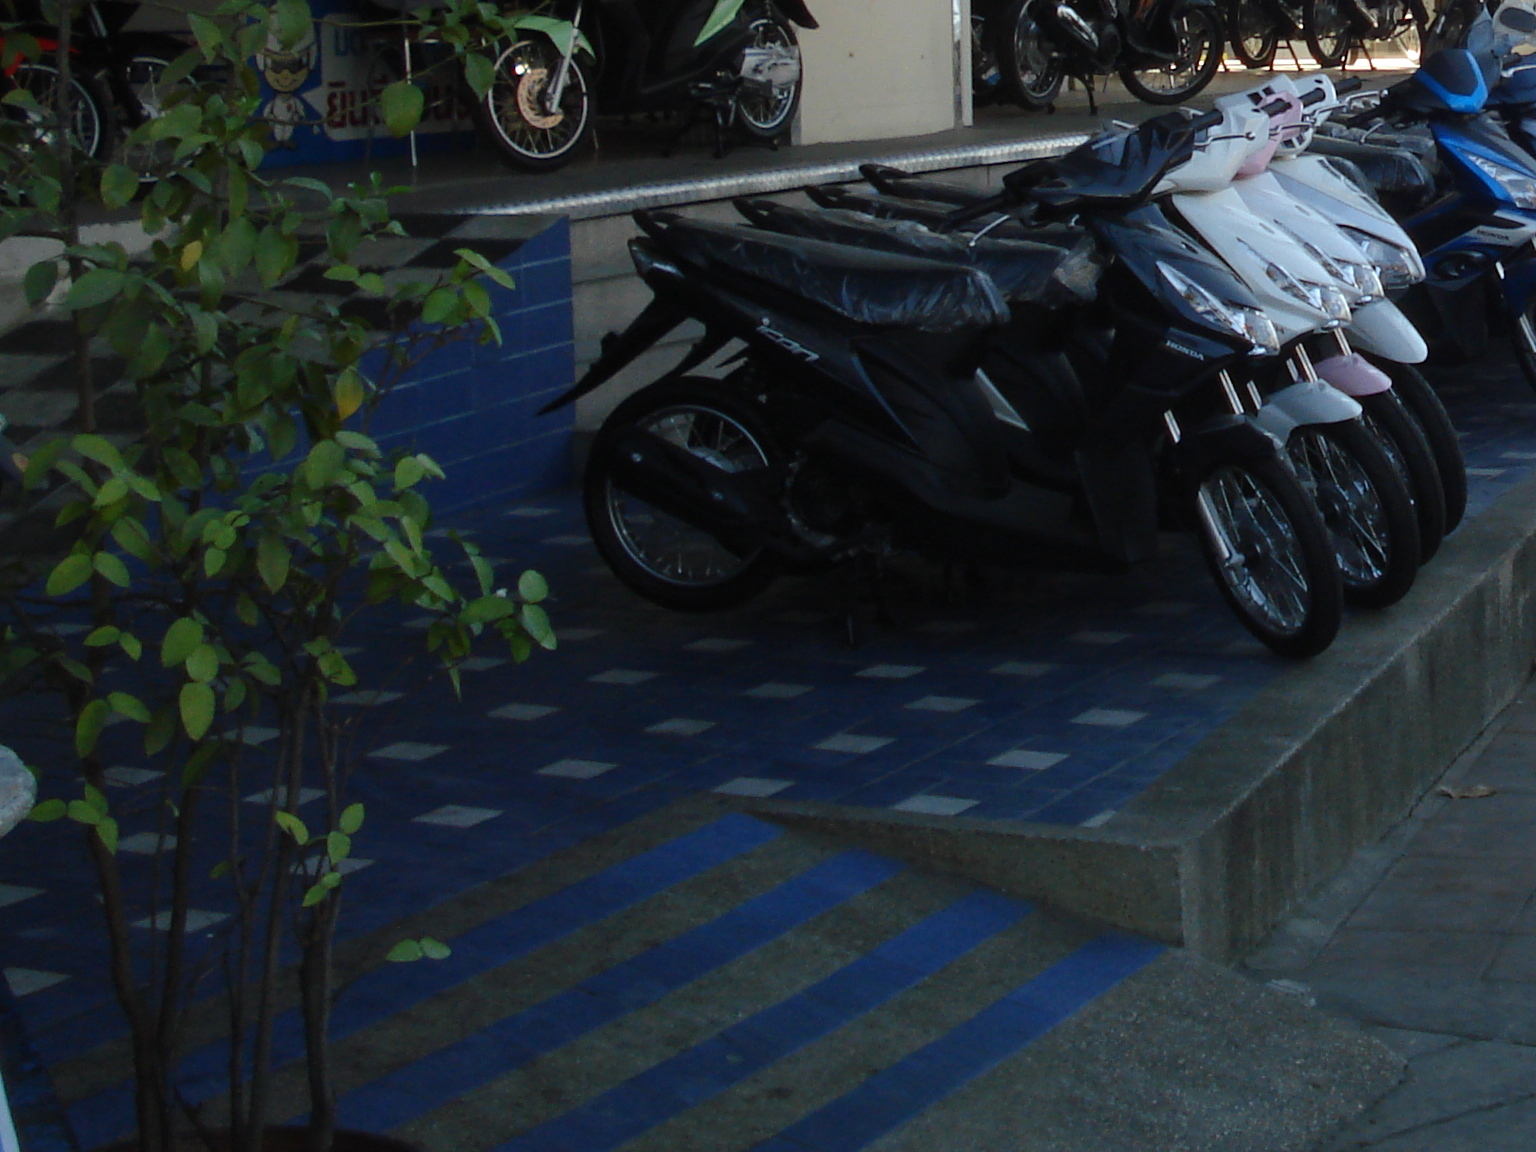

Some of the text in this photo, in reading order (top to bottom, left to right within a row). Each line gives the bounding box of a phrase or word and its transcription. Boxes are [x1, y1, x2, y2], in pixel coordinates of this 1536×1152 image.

[1475, 227, 1511, 243] HONDA
[755, 317, 821, 364] icon
[1165, 338, 1205, 362] HONDA
